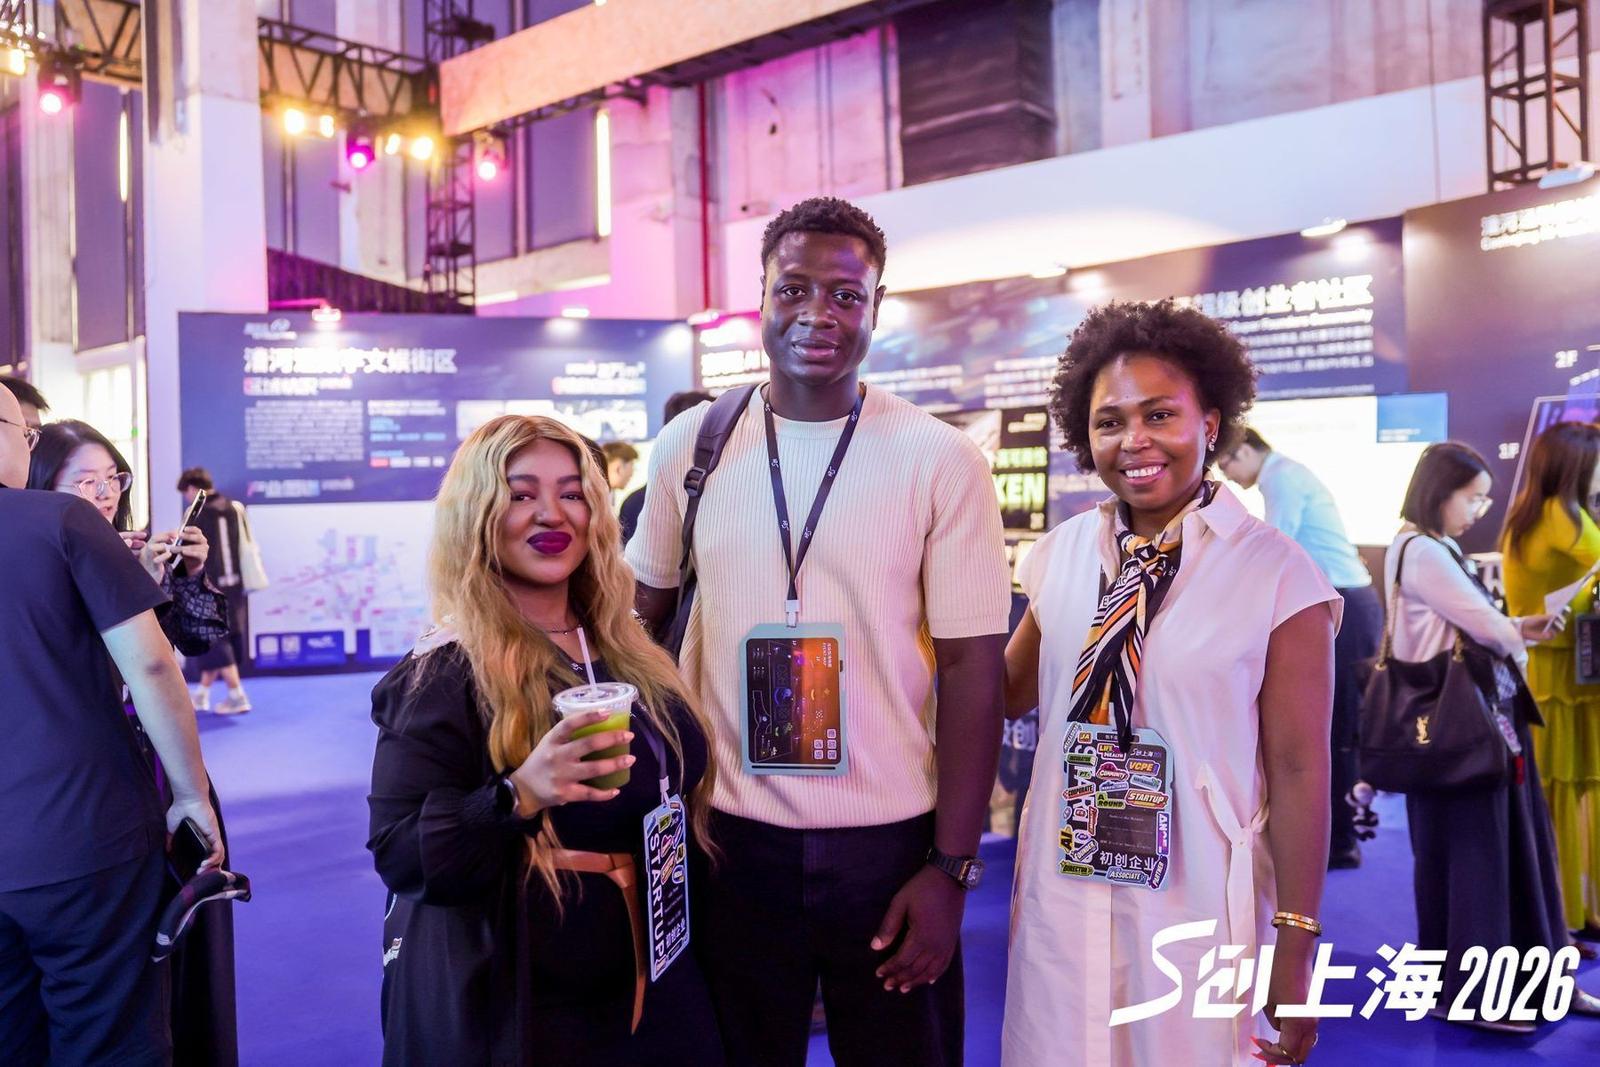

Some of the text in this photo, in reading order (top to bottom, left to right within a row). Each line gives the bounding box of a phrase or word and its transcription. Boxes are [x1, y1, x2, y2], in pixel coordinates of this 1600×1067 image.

[1129, 761, 1154, 772] VCPE
[1129, 792, 1164, 804] STARTUP
[1099, 850, 1156, 872] 初创企业
[649, 832, 665, 957] STARTUP
